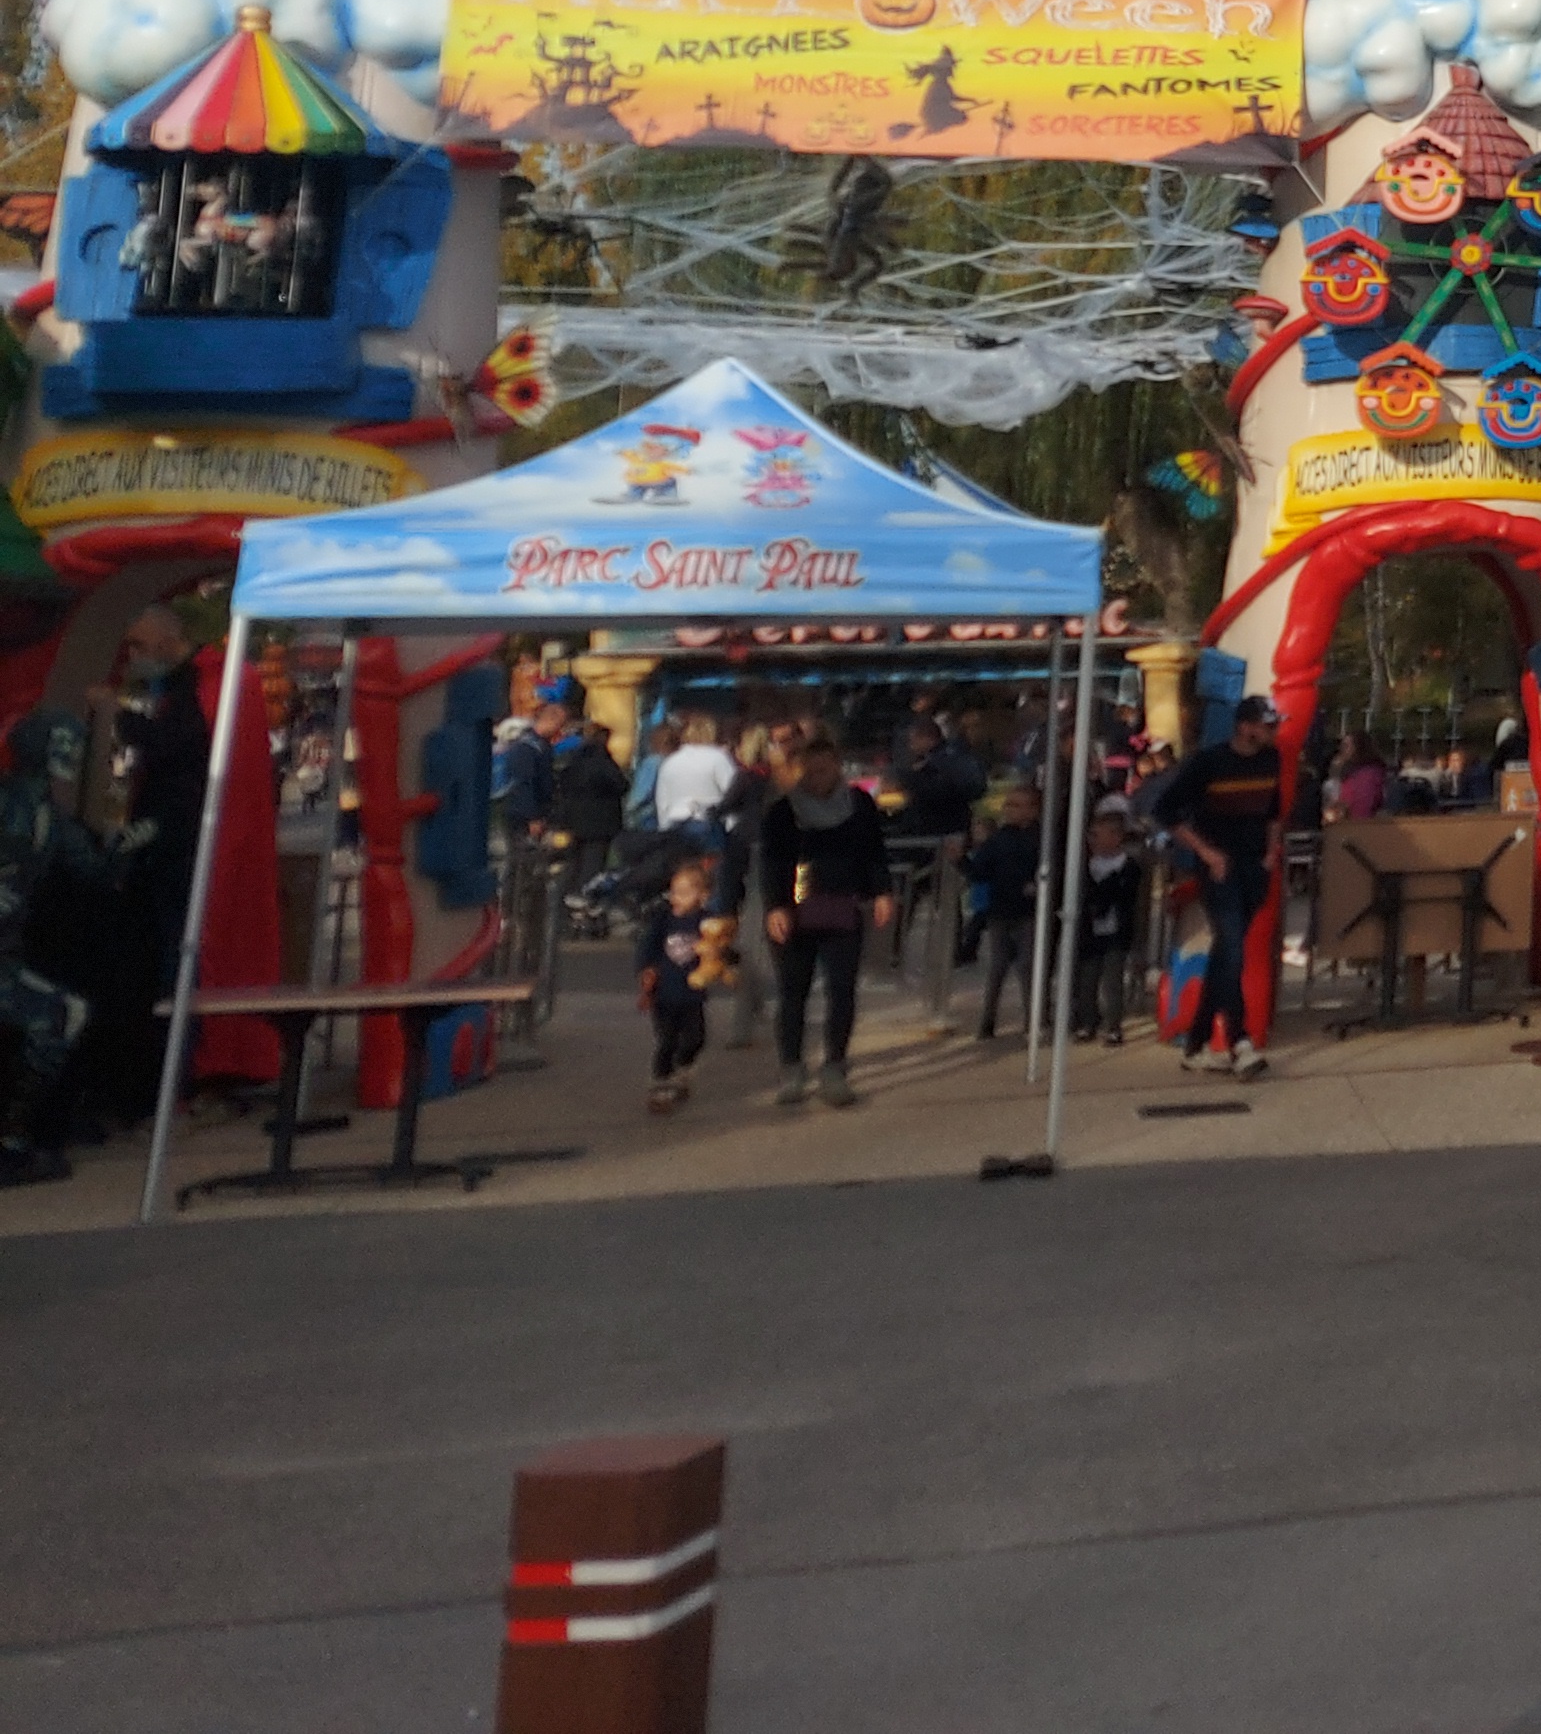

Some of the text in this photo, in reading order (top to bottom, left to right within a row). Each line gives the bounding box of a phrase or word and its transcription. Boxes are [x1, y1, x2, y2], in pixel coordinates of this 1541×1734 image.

[655, 27, 851, 65] ARAIGNEES
[982, 41, 1205, 67] SQUELETTES
[753, 72, 892, 98] MONSTRES
[1066, 75, 1283, 101] FANTOMES
[1025, 112, 1203, 137] SORCIERES
[502, 535, 866, 593] PARC SAINT PAUL
